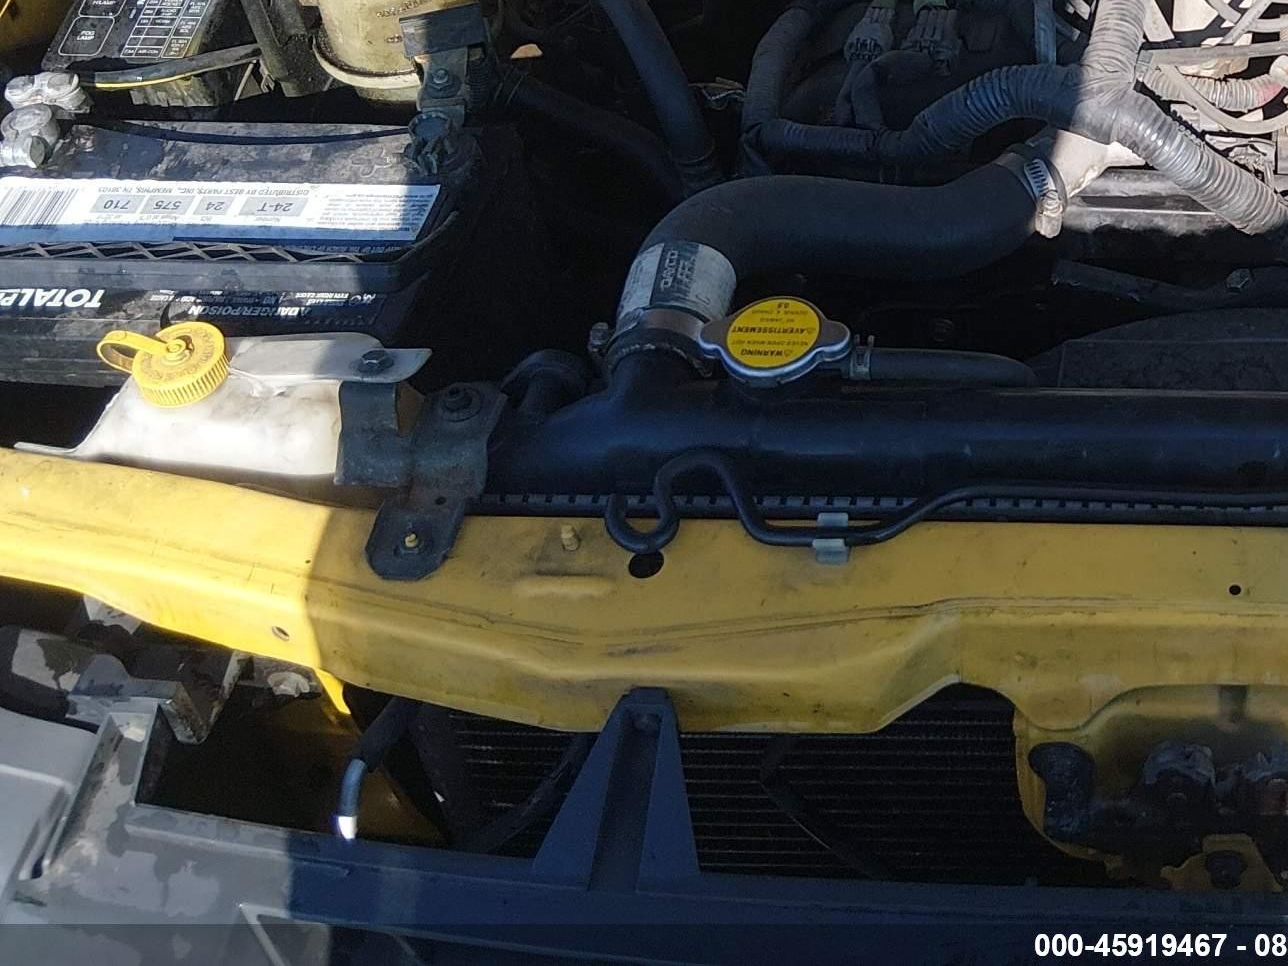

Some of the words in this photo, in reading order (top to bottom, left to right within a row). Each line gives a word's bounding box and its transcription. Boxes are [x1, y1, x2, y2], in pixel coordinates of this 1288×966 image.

[258, 187, 310, 195] DISTRIBUTED
[103, 199, 131, 210] 710
[153, 200, 182, 210] 575
[205, 201, 226, 211] 24
[257, 202, 295, 212] 24-T
[0, 288, 105, 308] TOTALP
[732, 326, 805, 334] AVERTISSEMENT
[741, 348, 783, 356] WARNING
